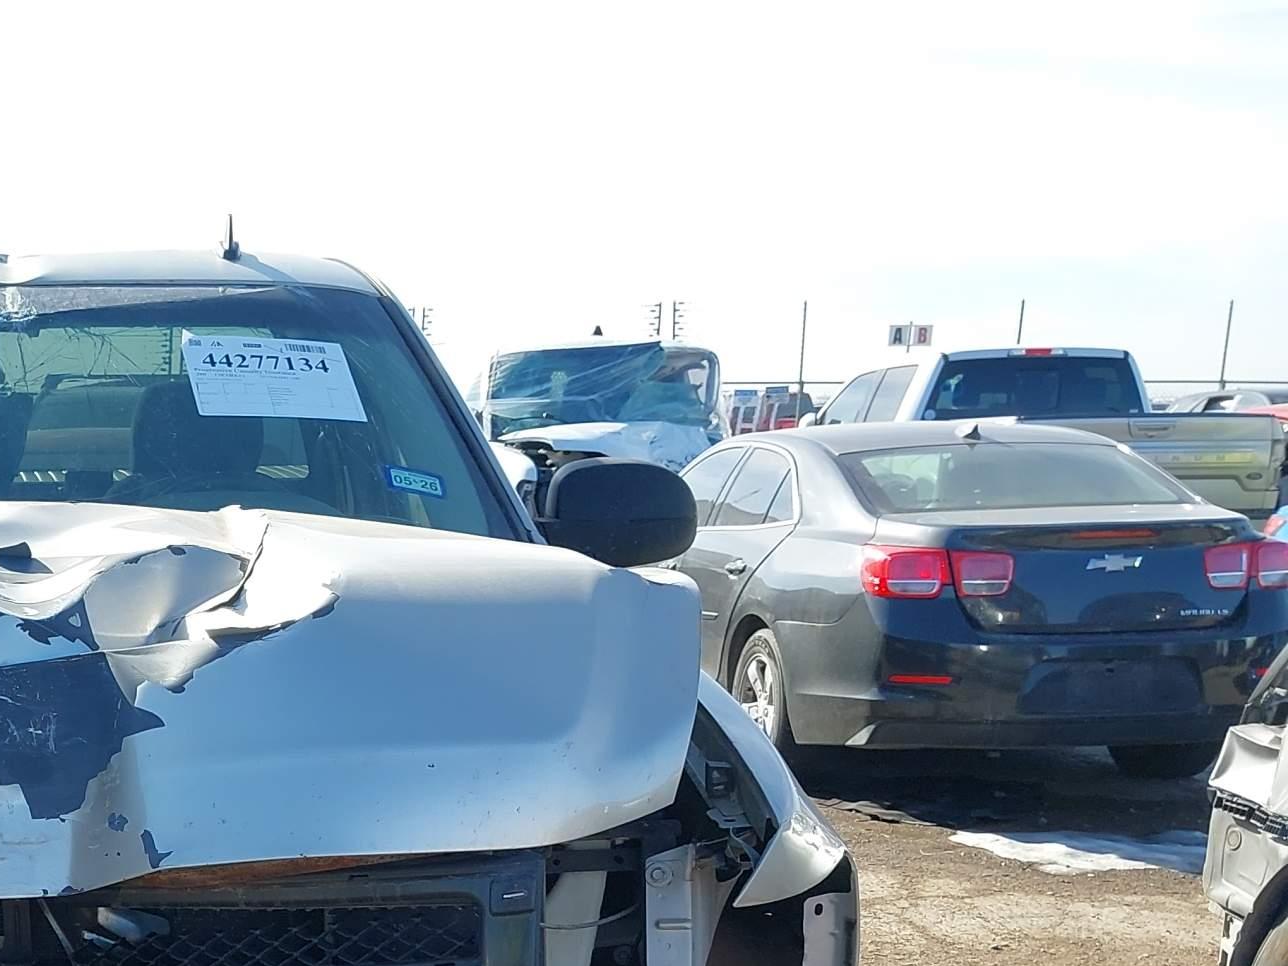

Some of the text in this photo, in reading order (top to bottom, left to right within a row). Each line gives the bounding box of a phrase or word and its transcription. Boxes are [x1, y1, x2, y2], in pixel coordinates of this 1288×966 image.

[892, 327, 903, 345] A
[917, 327, 928, 344] B
[202, 353, 330, 373] 44277134
